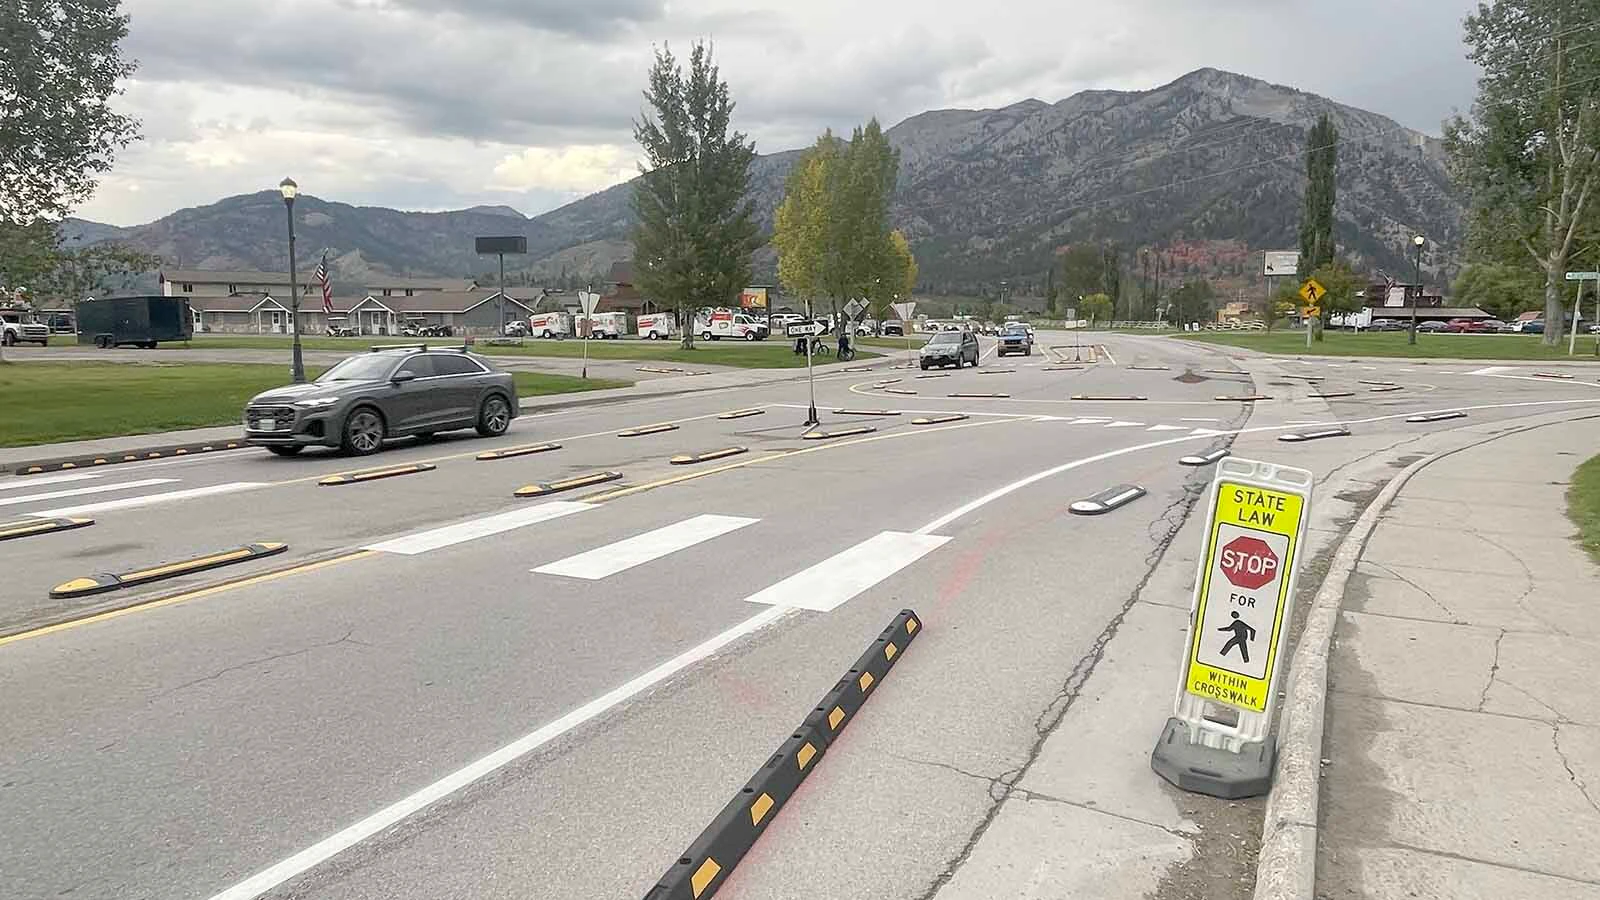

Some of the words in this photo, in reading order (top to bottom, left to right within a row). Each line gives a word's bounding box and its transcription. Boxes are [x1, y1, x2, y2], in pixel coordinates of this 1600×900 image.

[791, 326, 802, 334] ONE
[804, 325, 816, 333] WAY
[1234, 489, 1286, 511] STATE
[1238, 508, 1275, 527] LAW
[1221, 549, 1277, 576] STOP
[1229, 593, 1256, 608] FOR
[1209, 671, 1247, 691] WITHIN
[1194, 681, 1257, 707] CROSSWALK
